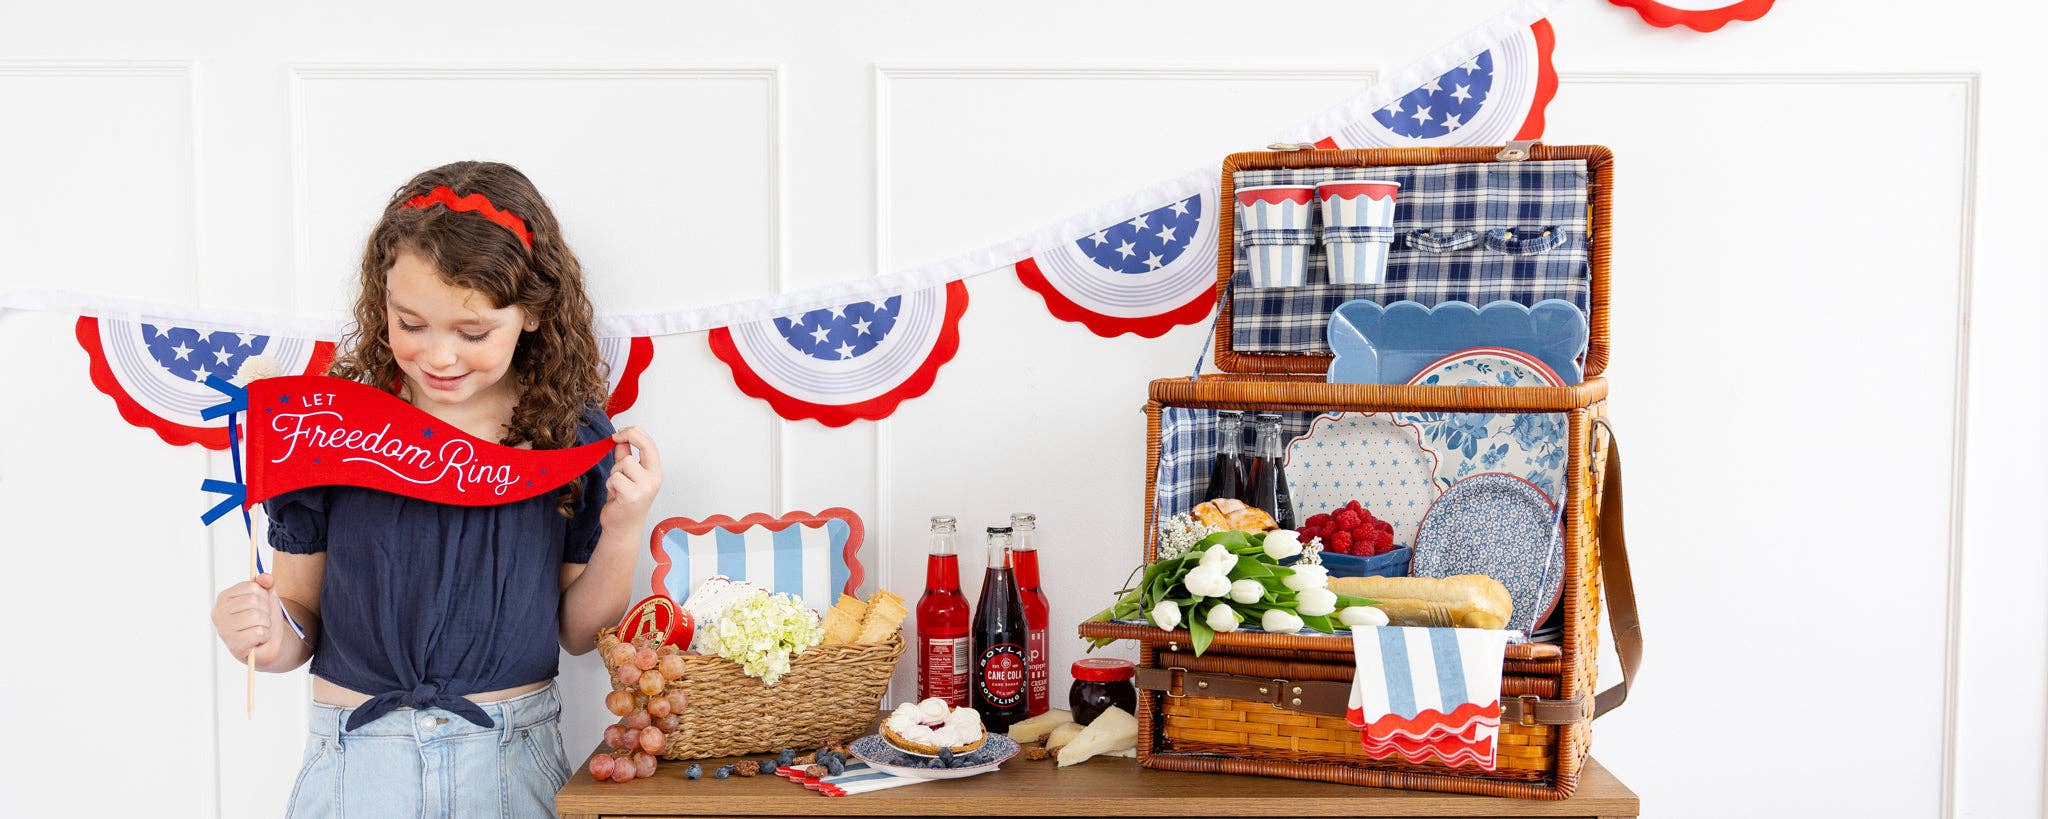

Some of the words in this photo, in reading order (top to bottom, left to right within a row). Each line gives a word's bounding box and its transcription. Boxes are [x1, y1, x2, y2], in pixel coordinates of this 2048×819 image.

[302, 393, 337, 408] LET
[271, 410, 436, 468] Freedom
[415, 438, 520, 495] Ring
[987, 670, 1005, 680] CANE
[1007, 670, 1022, 680] COLA
[980, 681, 1020, 704] BOTTLING
